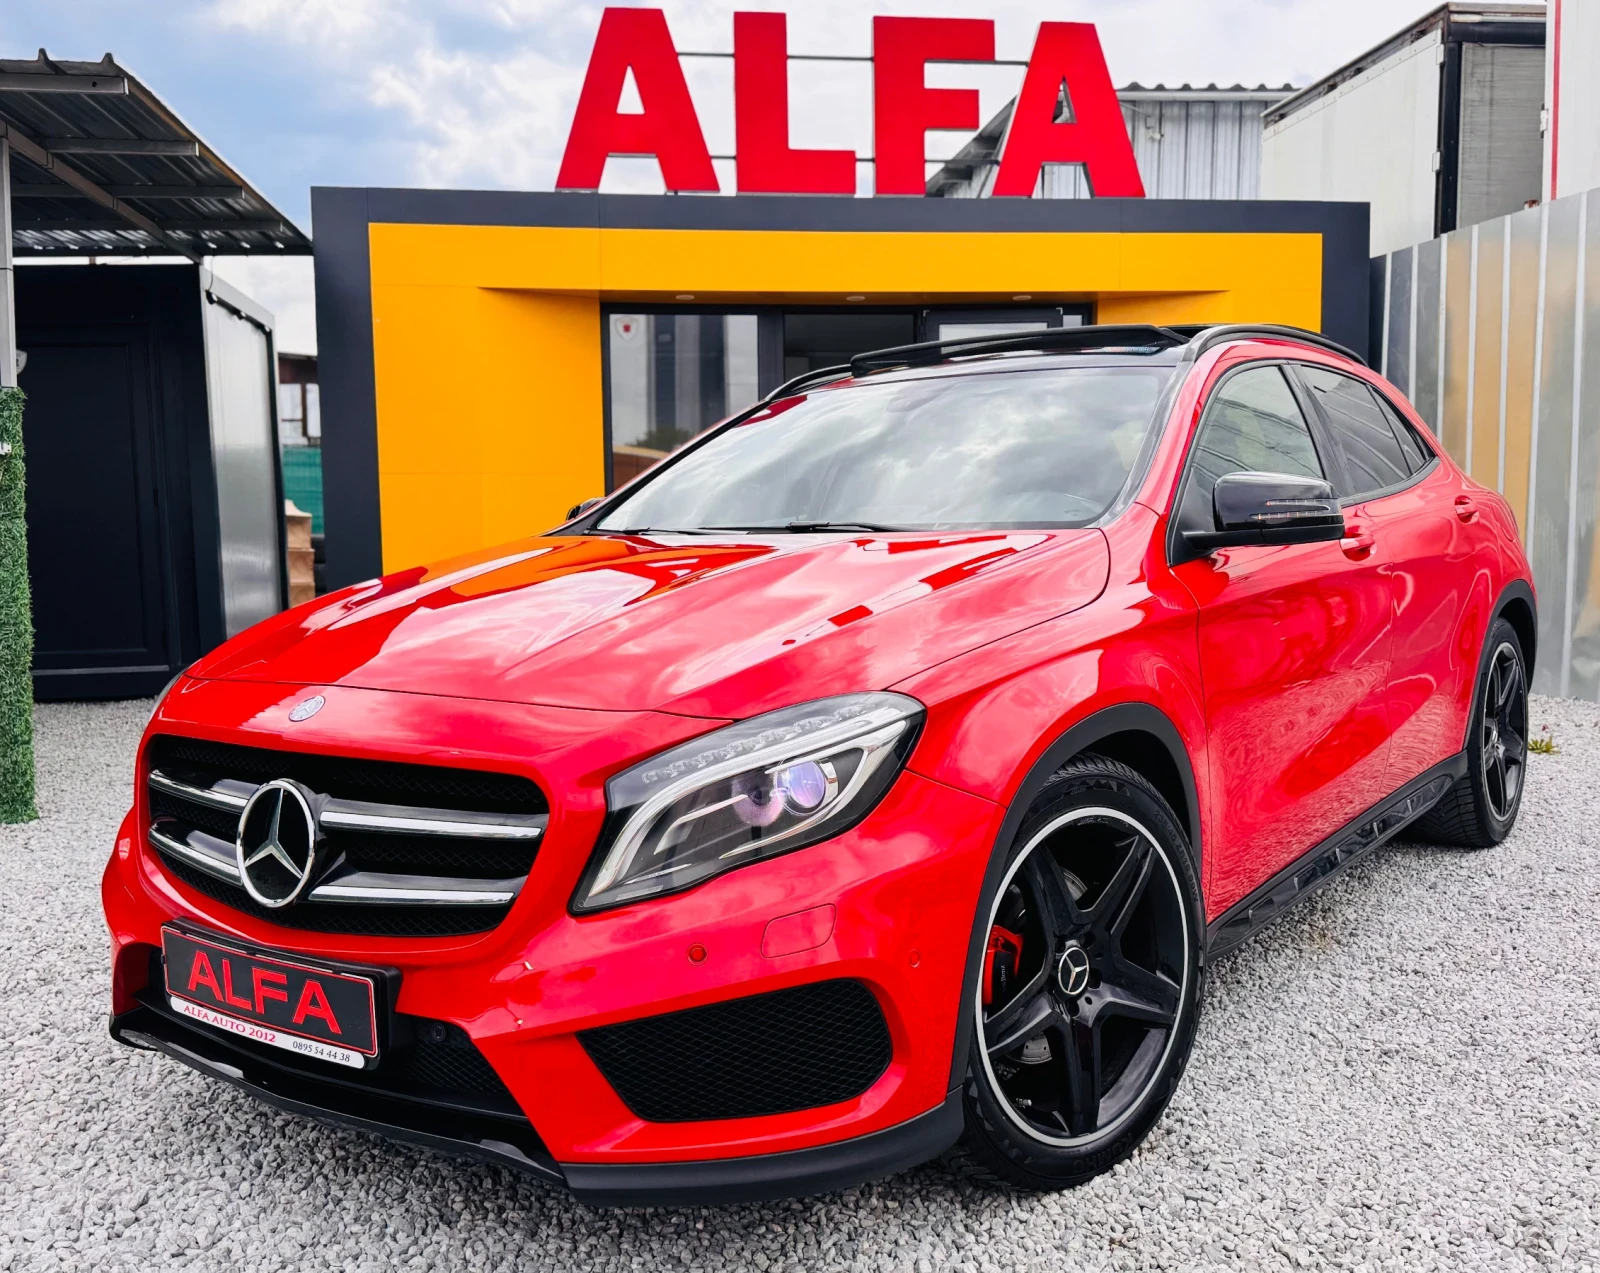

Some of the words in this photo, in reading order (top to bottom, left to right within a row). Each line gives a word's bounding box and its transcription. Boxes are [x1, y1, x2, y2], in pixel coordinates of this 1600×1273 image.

[555, 7, 1146, 198] ALFA
[188, 950, 342, 1035] ALFA
[184, 1004, 210, 1021] ALFA
[211, 1015, 246, 1033] AUTO
[249, 1027, 276, 1043] 2012
[292, 1040, 313, 1054] 0895
[314, 1046, 325, 1056] 54
[326, 1050, 338, 1060] 44
[339, 1053, 351, 1063] 38
[1073, 1132, 1134, 1174] KUMHO
